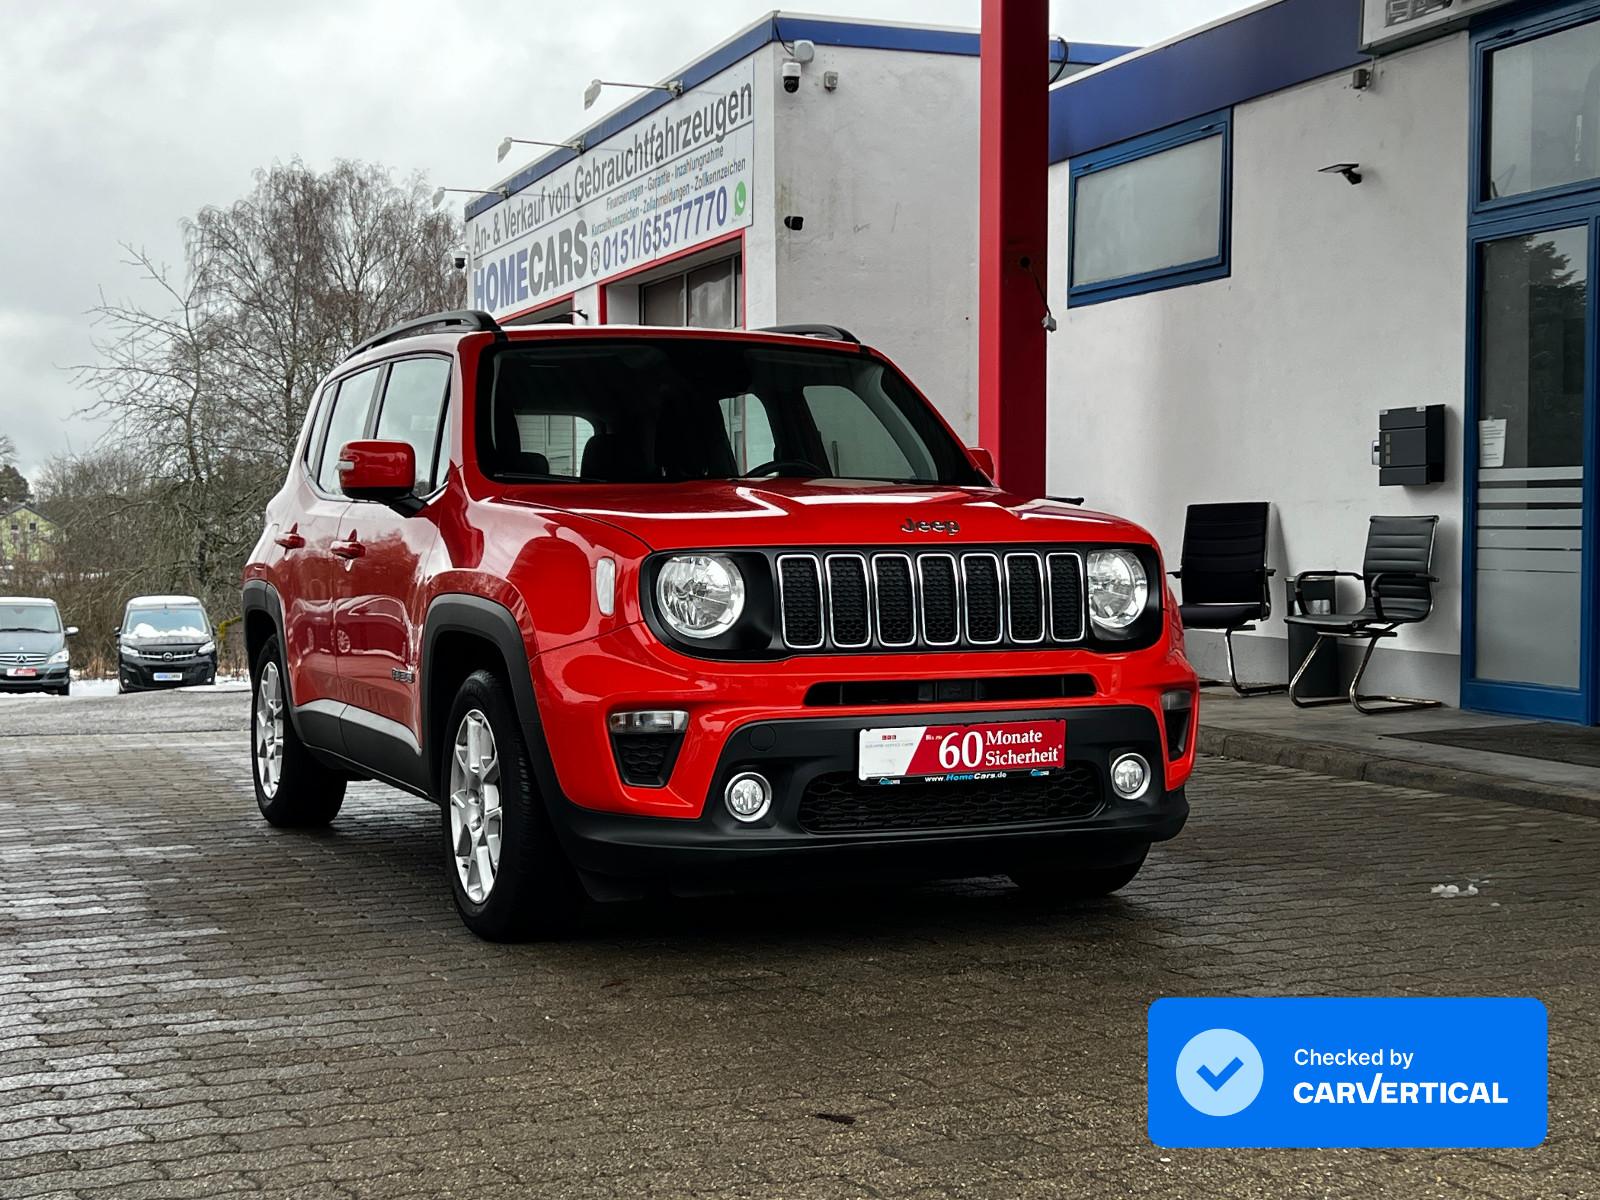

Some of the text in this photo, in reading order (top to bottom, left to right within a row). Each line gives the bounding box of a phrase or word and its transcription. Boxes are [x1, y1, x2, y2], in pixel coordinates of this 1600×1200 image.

[473, 82, 752, 255] An- & Verkauf von Gebrauchtfahrzeugen
[694, 157, 746, 191] Zollkennzeichen
[603, 185, 728, 271] 0151/65577770
[473, 219, 588, 314] HOMECARS
[900, 517, 960, 536] Jeep
[938, 731, 984, 769] 60
[985, 730, 1042, 746] Monate
[924, 771, 1007, 783] www.HomeCars.de
